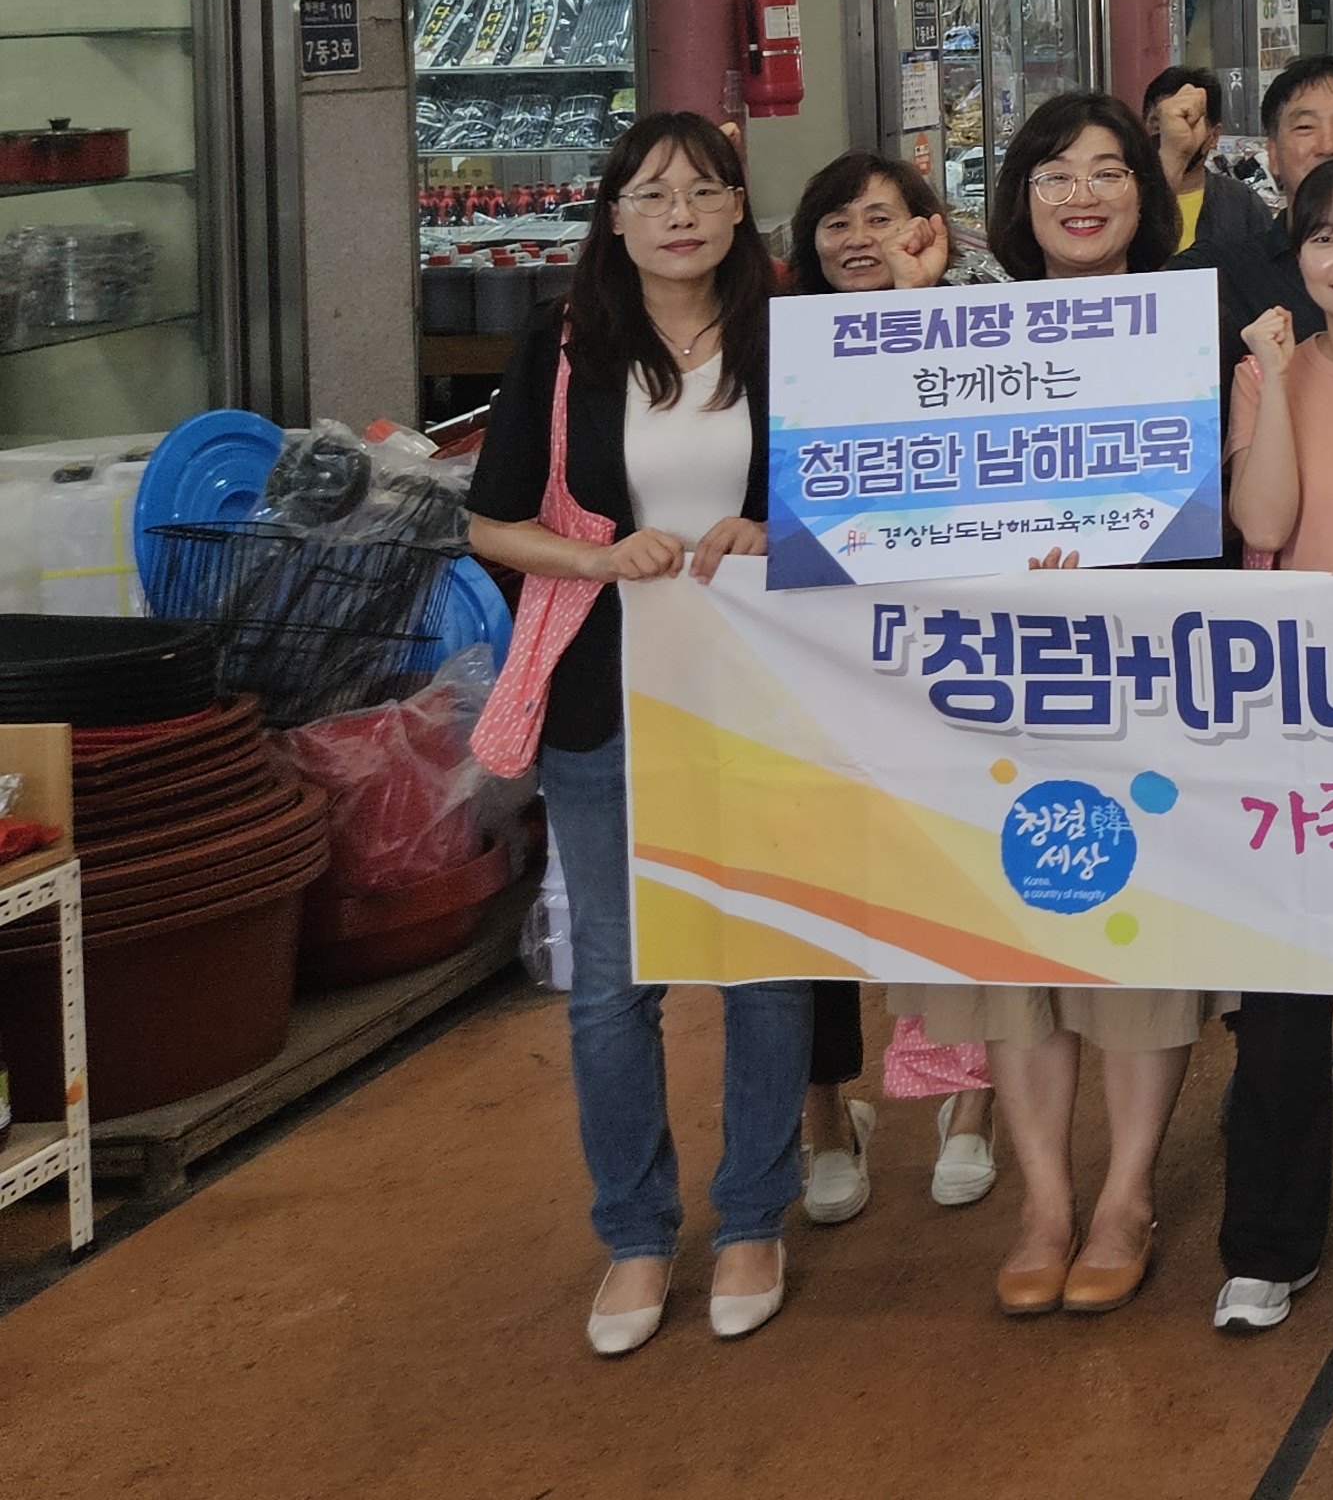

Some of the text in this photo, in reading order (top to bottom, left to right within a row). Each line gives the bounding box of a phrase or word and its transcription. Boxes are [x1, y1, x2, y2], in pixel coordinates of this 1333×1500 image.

[331, 3, 352, 20] 110
[305, 38, 355, 66] 7동3호
[833, 293, 1157, 358] 전통시장 장보기
[913, 360, 1081, 409] 함께하는
[799, 417, 1192, 499] 청렴한 남해교육
[878, 507, 1154, 550] 경상남도남해교육지원청
[1036, 841, 1111, 881] 세상
